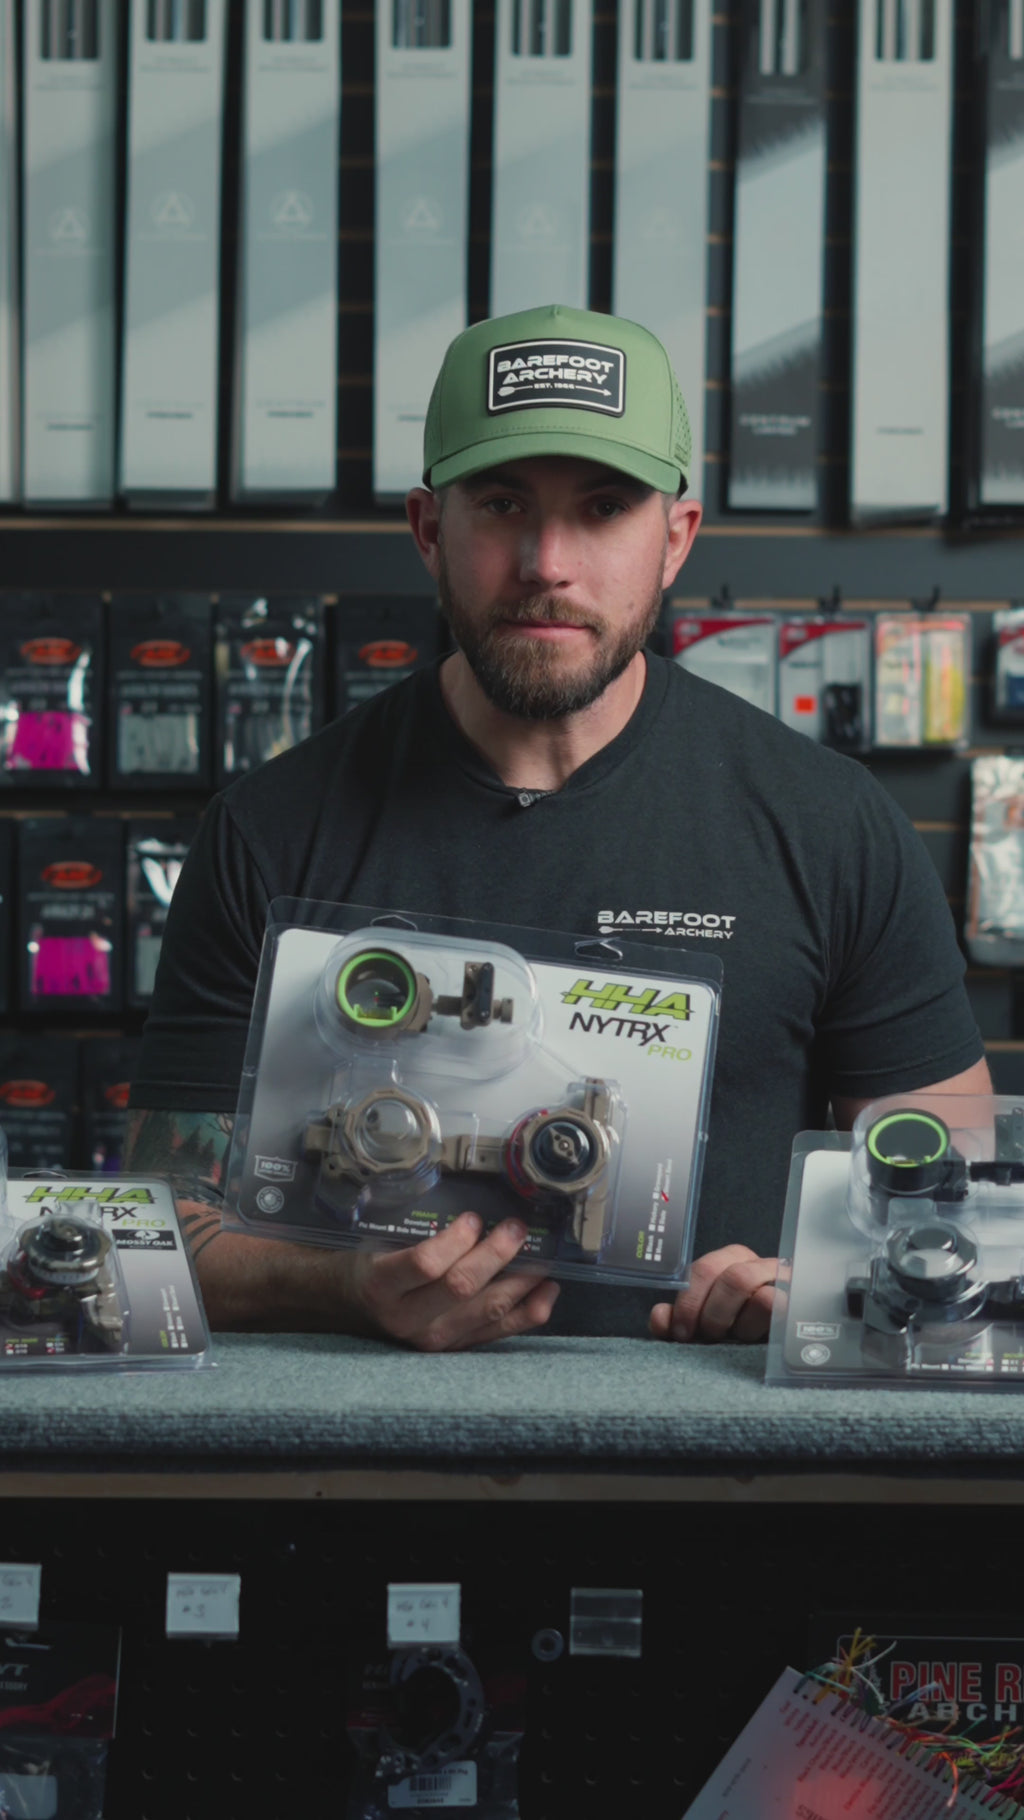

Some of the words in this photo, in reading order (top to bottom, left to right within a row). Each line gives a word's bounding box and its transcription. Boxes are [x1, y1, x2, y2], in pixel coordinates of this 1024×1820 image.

[497, 355, 614, 373] BAREFOOT
[502, 368, 607, 385] ARCHERY
[597, 910, 736, 929] BAREFOOT
[664, 927, 734, 939] ARCHERY
[561, 979, 692, 1021] HHA
[569, 1012, 670, 1046] NYTRX
[647, 1045, 692, 1061] PRO
[22, 1186, 157, 1204] HHA
[39, 1206, 138, 1221] NRX
[122, 1219, 166, 1228] PRO
[890, 1660, 982, 1703] PINE
